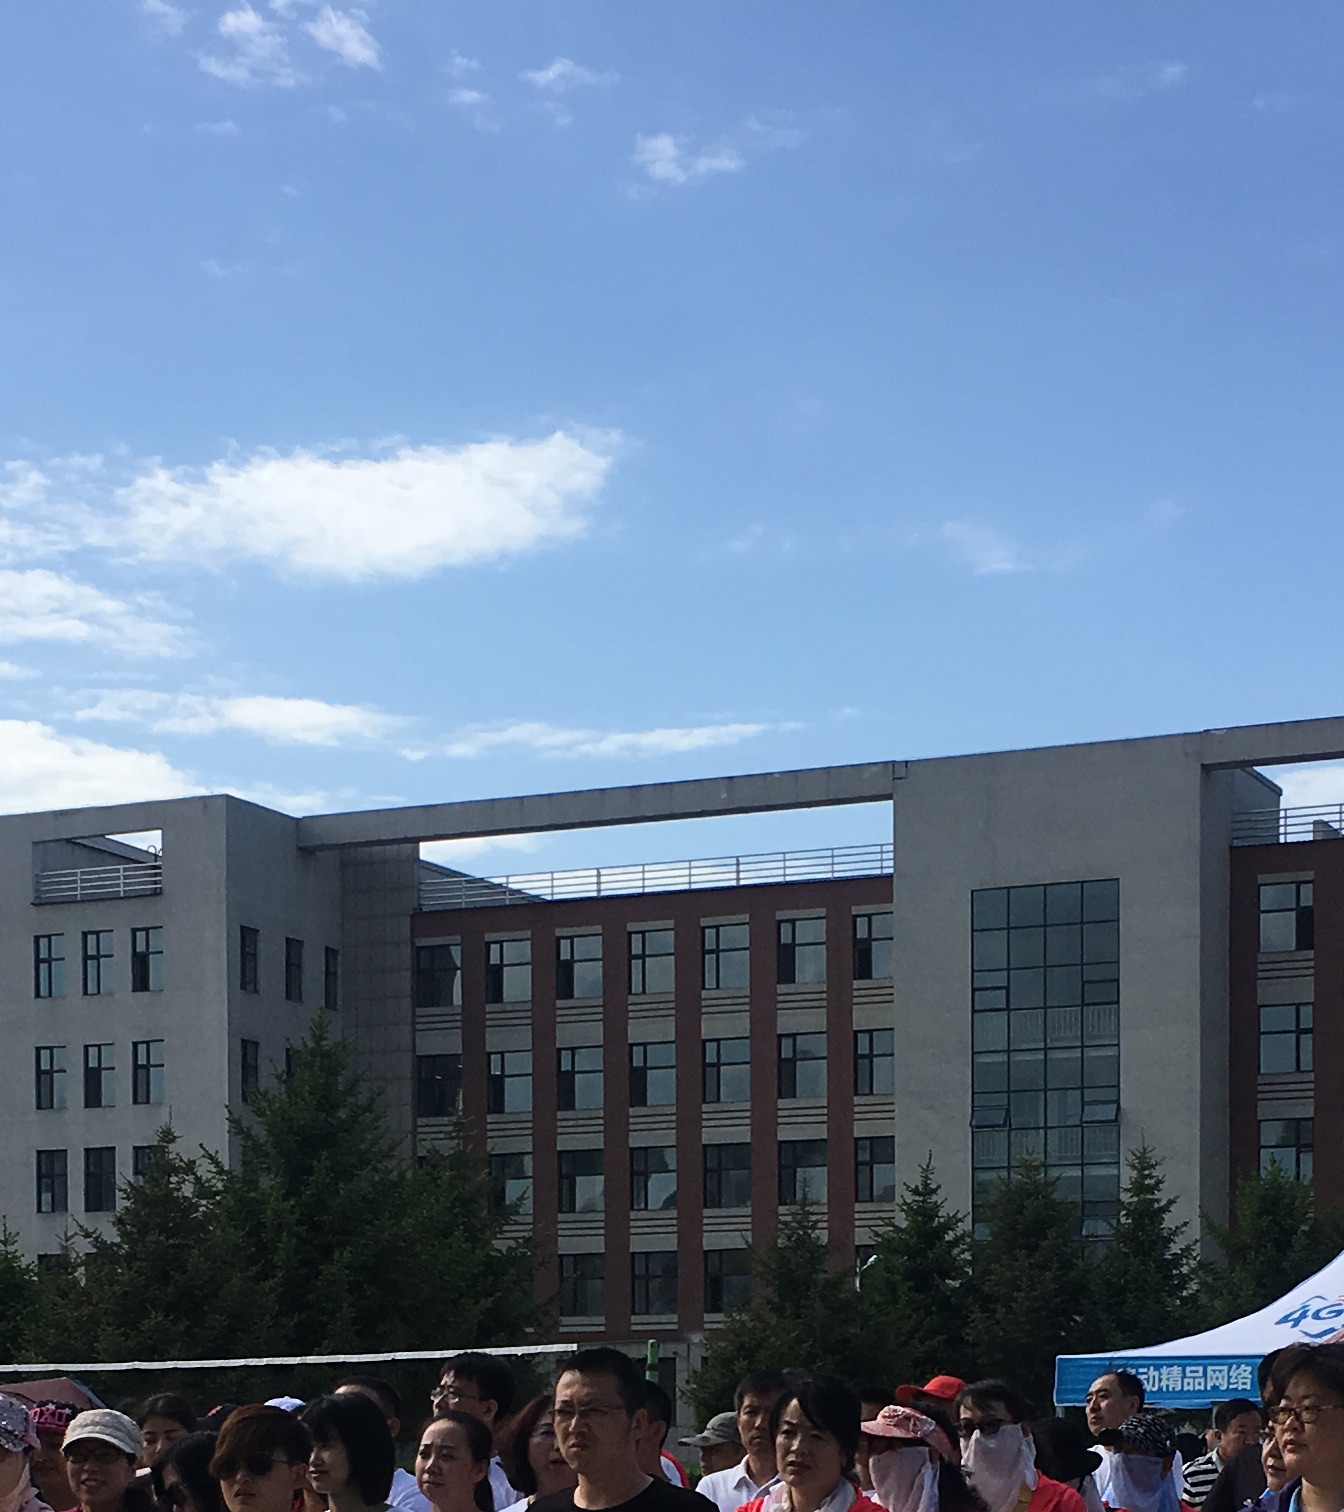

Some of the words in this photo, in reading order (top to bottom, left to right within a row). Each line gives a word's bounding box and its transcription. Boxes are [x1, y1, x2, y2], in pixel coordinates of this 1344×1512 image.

[1117, 1364, 1253, 1393] 动精品网络
